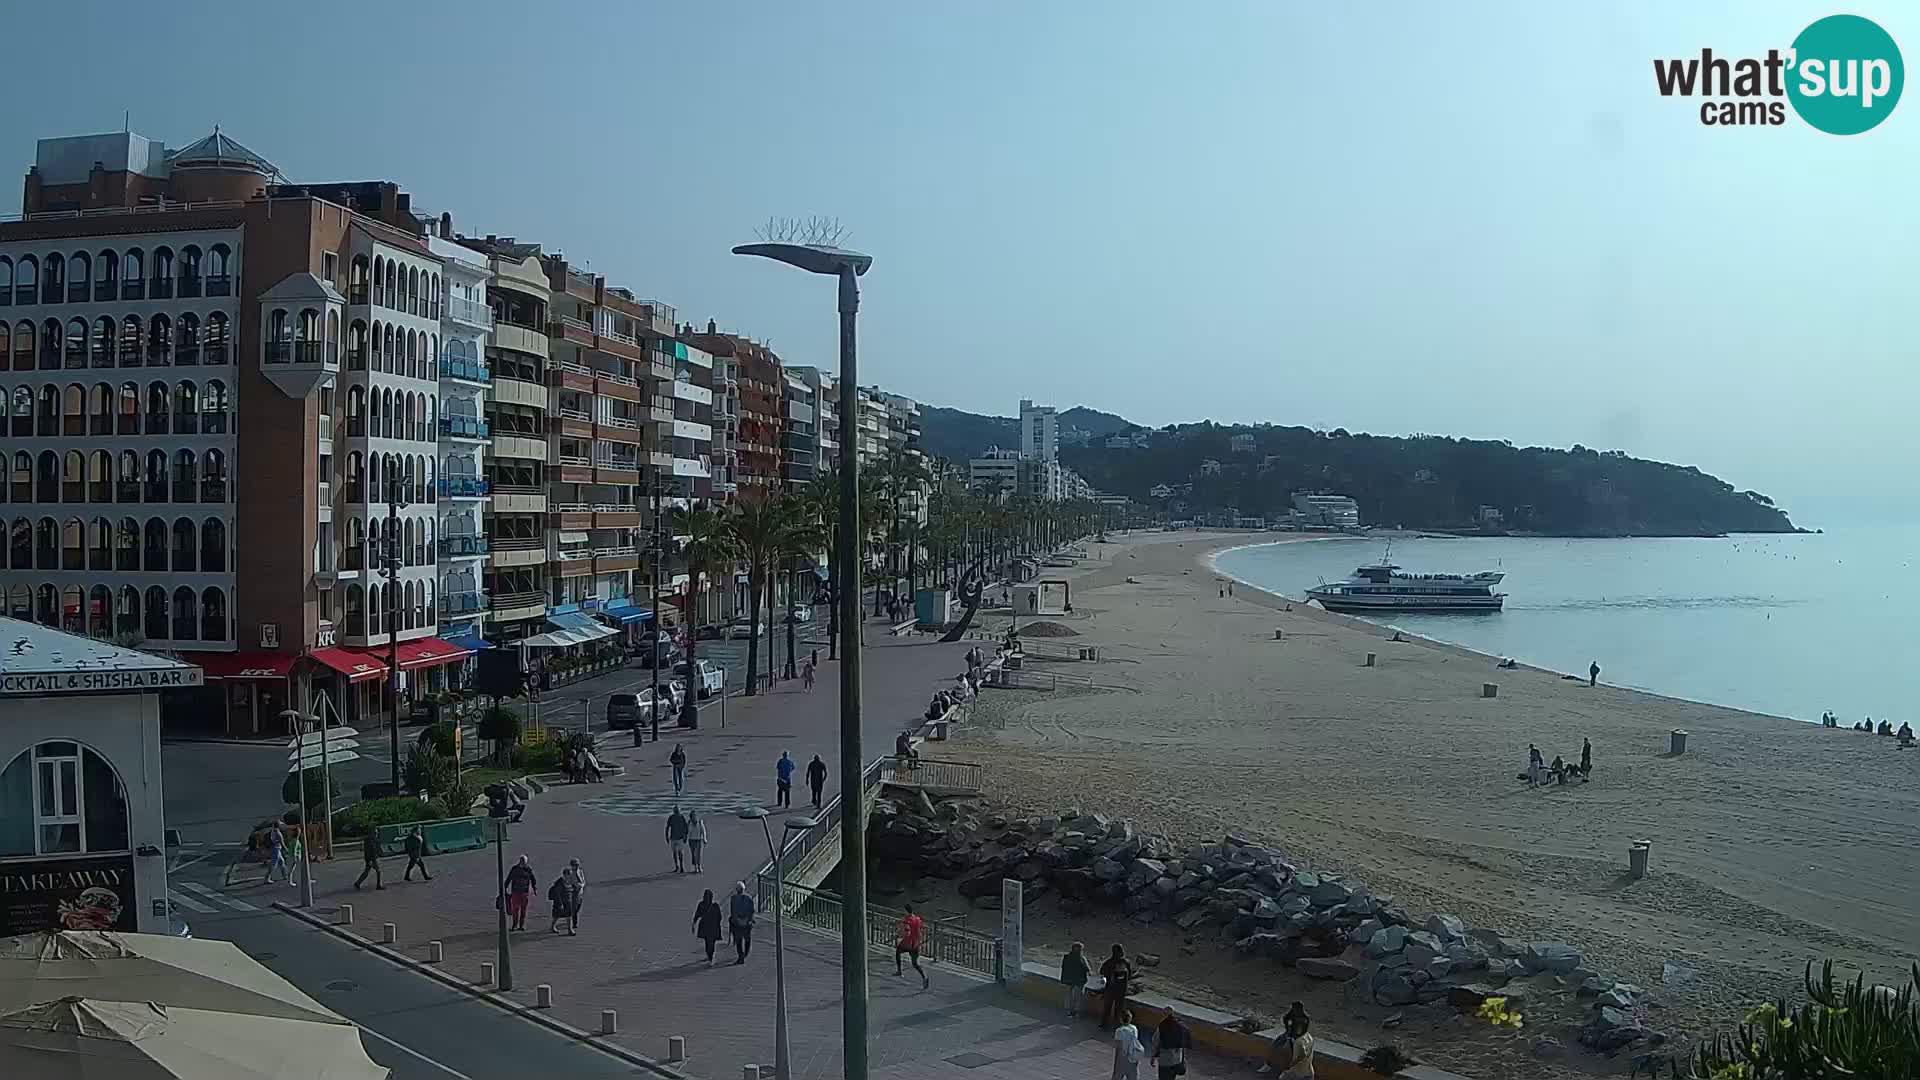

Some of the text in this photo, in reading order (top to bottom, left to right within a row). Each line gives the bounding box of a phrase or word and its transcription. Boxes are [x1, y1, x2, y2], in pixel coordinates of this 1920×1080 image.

[317, 630, 336, 647] KFC
[68, 675, 78, 688] &
[84, 672, 144, 688] SHISHA
[150, 671, 182, 685] BAR
[240, 668, 276, 676] KFC
[1, 869, 126, 892] TAKEAWAY
